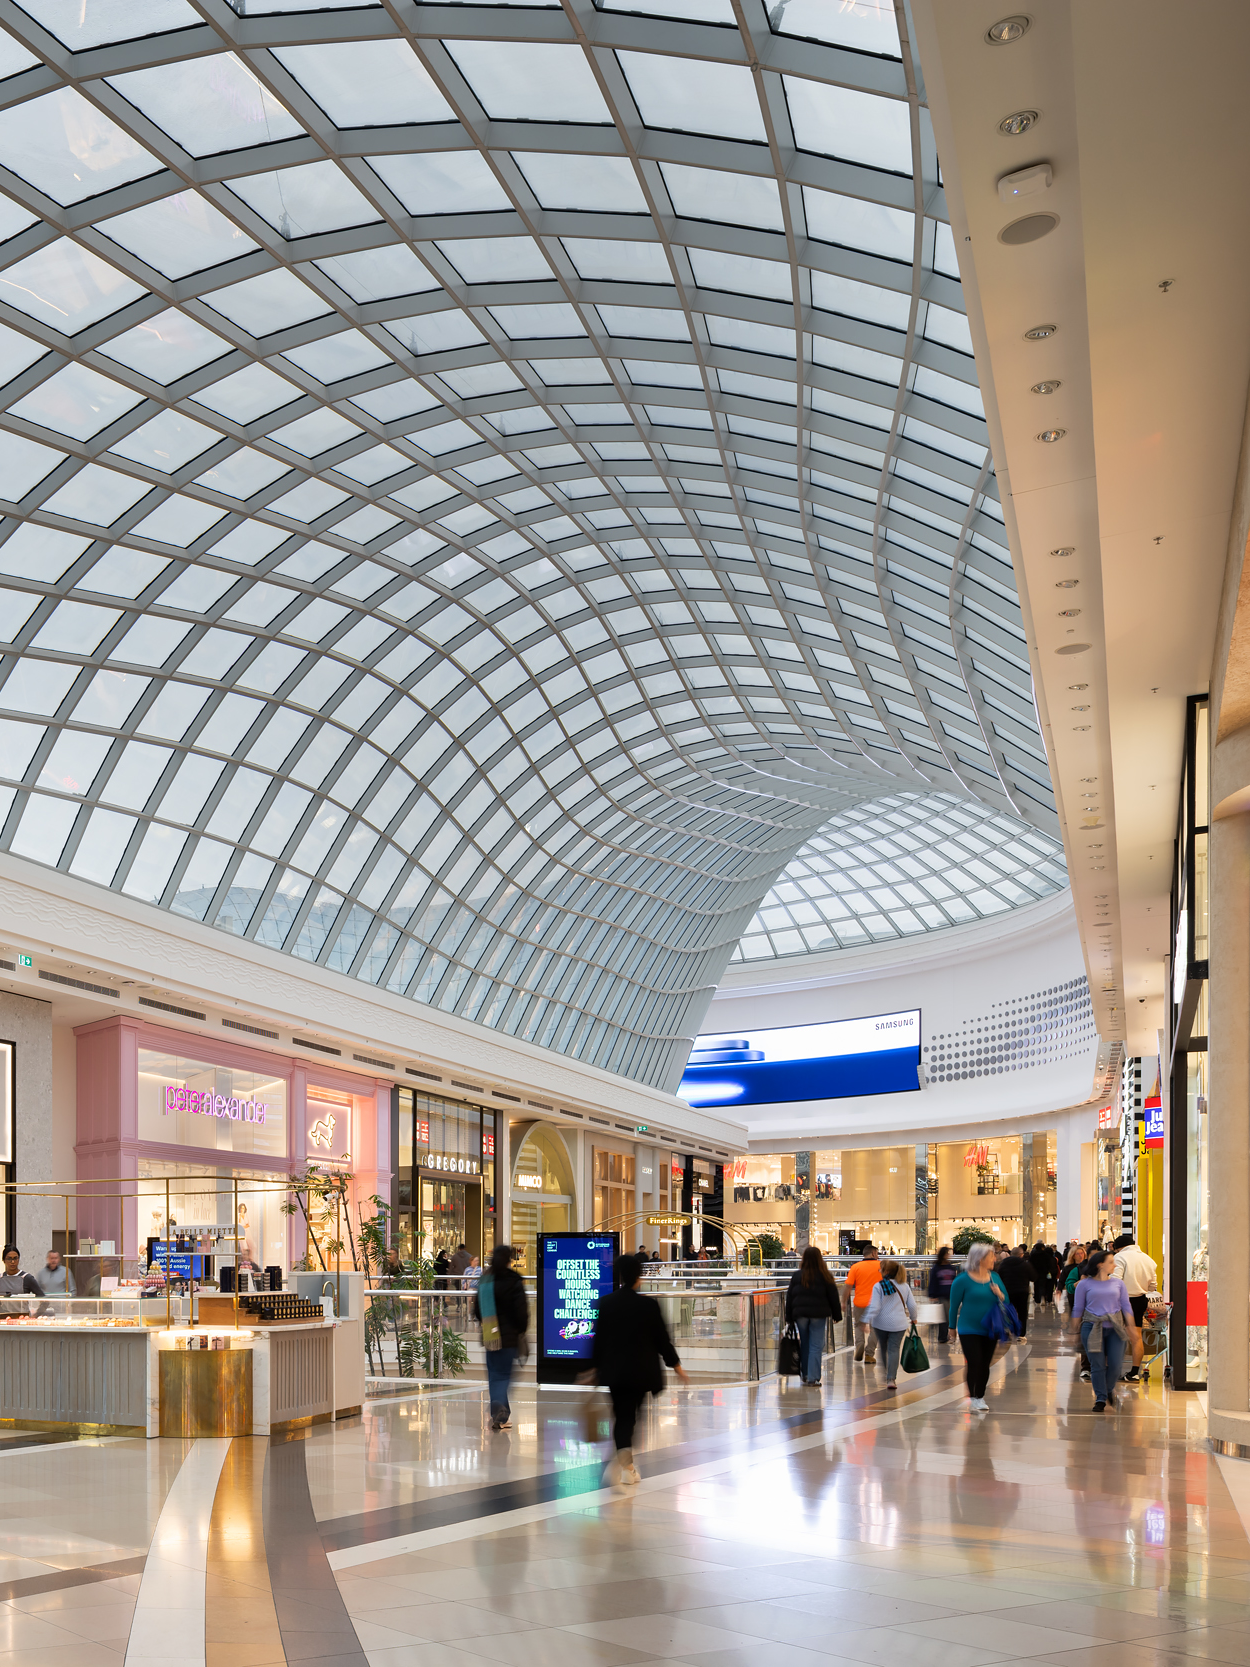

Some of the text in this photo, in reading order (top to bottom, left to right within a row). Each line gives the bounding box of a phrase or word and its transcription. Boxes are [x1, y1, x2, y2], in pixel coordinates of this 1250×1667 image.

[875, 1018, 914, 1031] SAMSUNG
[963, 1145, 989, 1168] H&M
[427, 1154, 477, 1175] GREGORY
[517, 1174, 543, 1189] MIMCO
[649, 1217, 688, 1226] FinerRings
[557, 1259, 600, 1270] OFFSET THE
[556, 1269, 600, 1280] COUNTLESS
[565, 1279, 591, 1290] HOURS
[558, 1289, 599, 1300] WATCHING
[565, 1299, 591, 1309] DANCE
